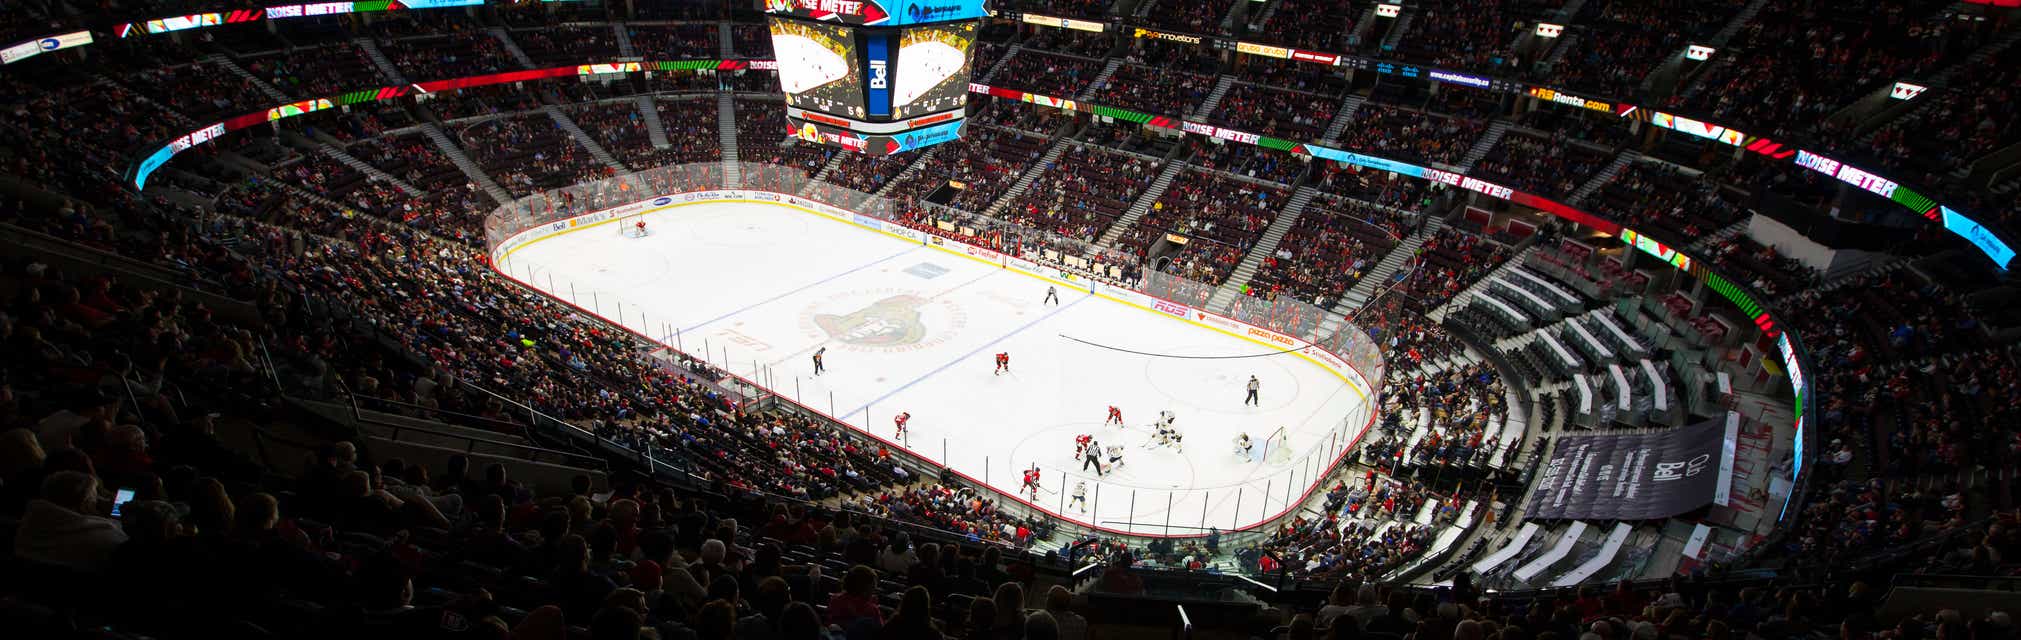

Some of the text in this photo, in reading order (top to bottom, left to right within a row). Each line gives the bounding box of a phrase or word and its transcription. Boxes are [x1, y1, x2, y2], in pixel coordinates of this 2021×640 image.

[266, 2, 353, 19] NOISE METER
[749, 60, 778, 70] NOISE
[870, 60, 886, 88] Bell
[191, 122, 225, 146] METER
[1182, 121, 1260, 146] NOISE METER
[1421, 168, 1513, 201] NOISE METER
[1795, 149, 1899, 199] NOISE METER
[1154, 301, 1188, 316] RDS
[1248, 328, 1294, 345] pizza pizza
[1653, 461, 1686, 481] Bell
